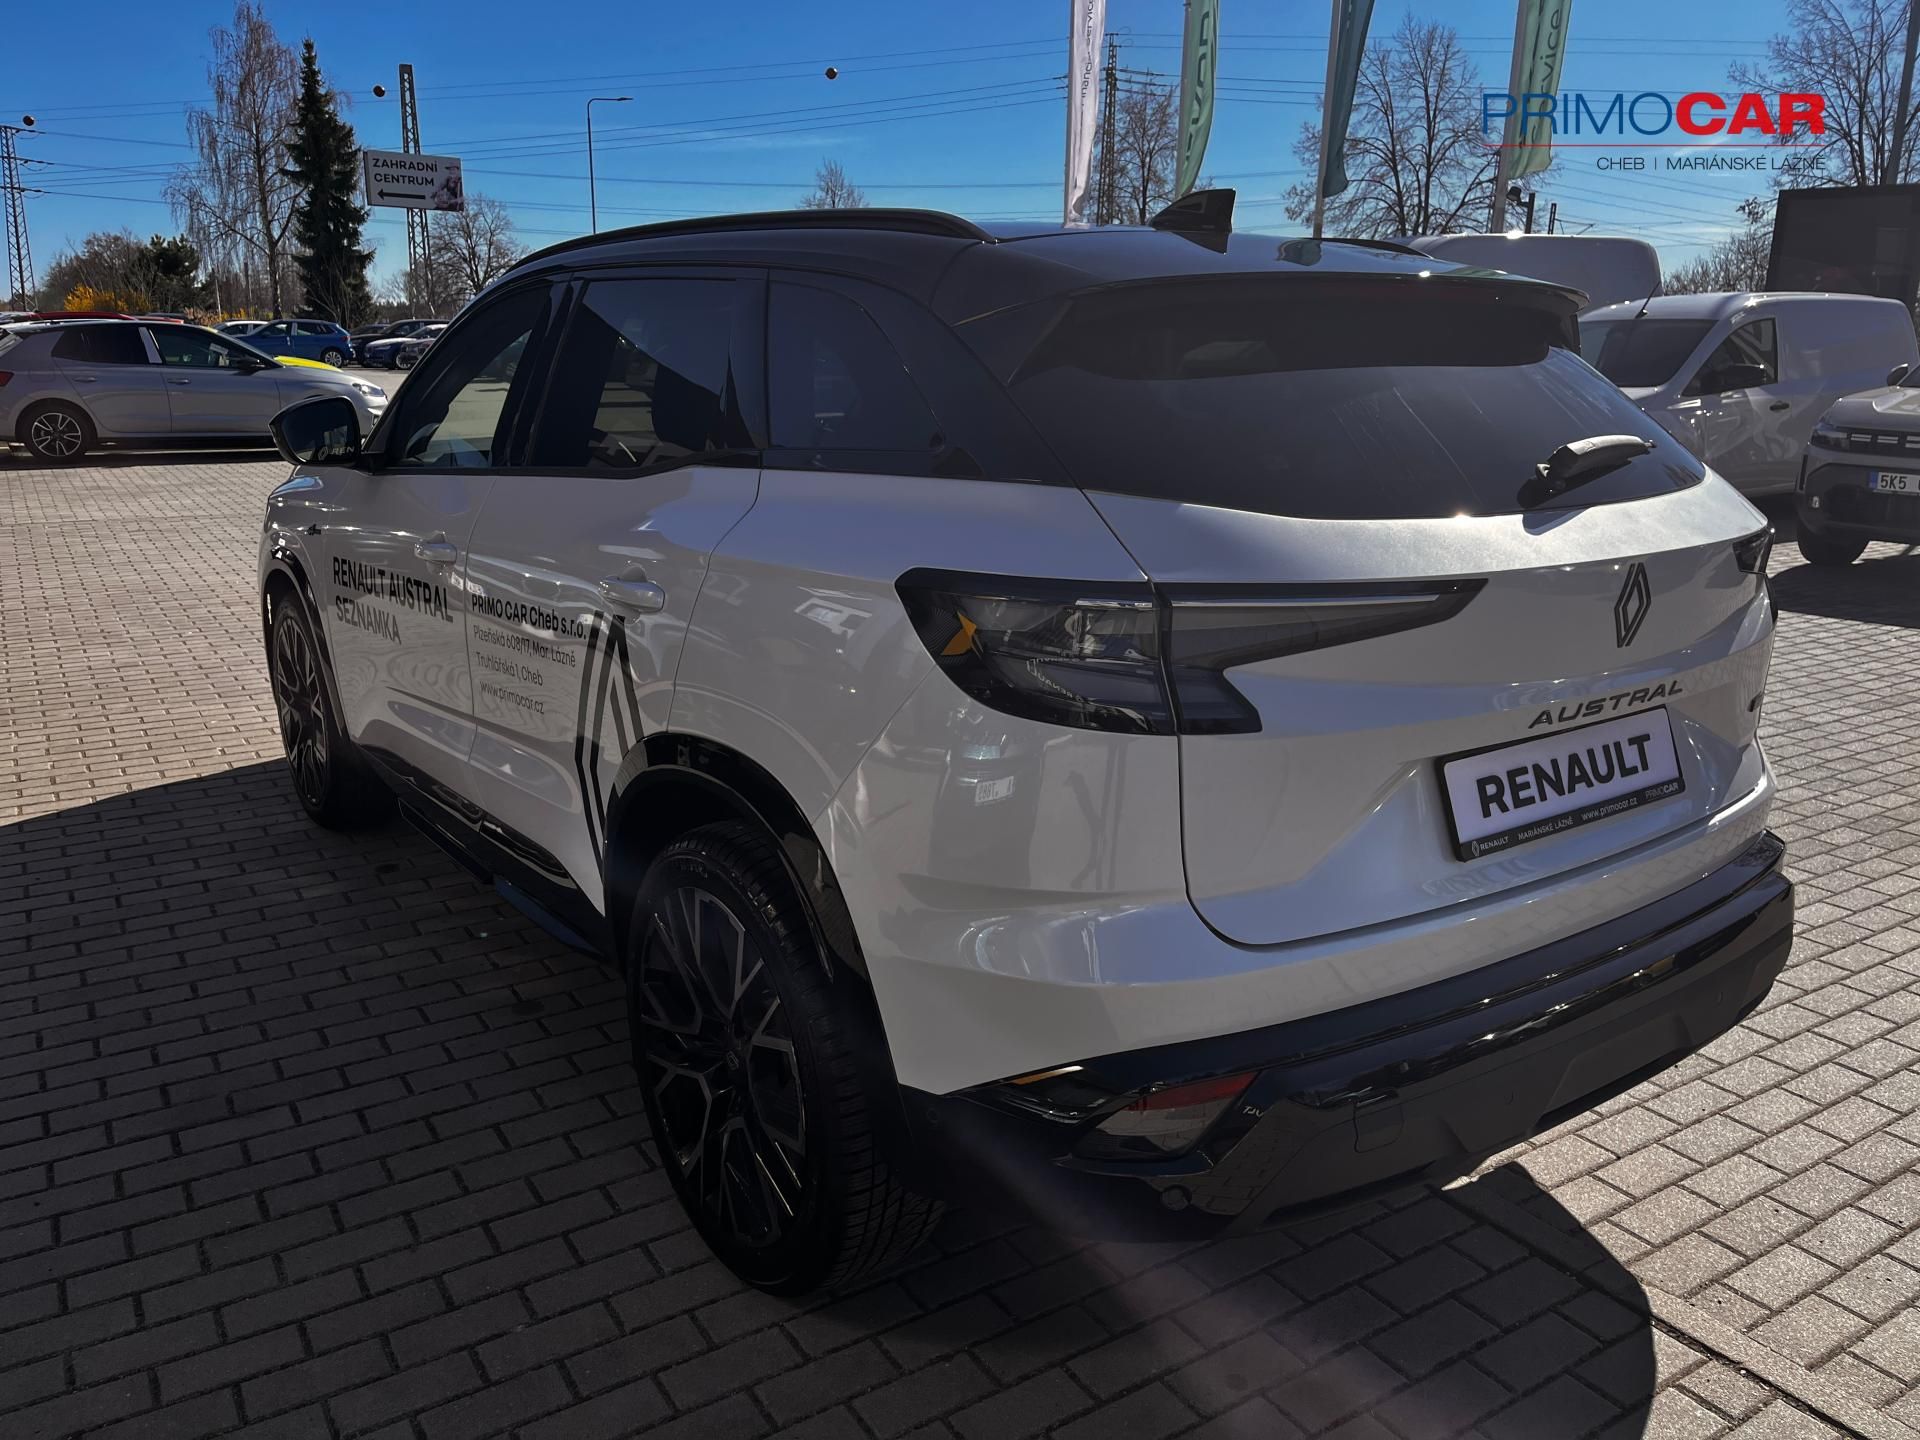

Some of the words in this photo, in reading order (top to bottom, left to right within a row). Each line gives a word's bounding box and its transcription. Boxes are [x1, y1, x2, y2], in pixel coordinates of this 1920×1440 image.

[372, 158, 438, 173] ZAHRADNÍ
[373, 173, 435, 187] CENTRUM
[1880, 474, 1907, 490] 5K5
[333, 556, 386, 600] RENAULT
[389, 572, 454, 624] AUSTRAL
[335, 595, 402, 646] SEZNAMKA
[471, 594, 503, 618] PRIMO
[504, 601, 528, 625] CAR
[529, 606, 559, 632] Cheb
[561, 617, 587, 640] s.r.o.
[473, 625, 506, 648] Plzeňská
[533, 641, 551, 660] Mar.
[551, 646, 576, 668] Lázně
[480, 681, 545, 715] www.primocar.cz
[521, 665, 544, 687] Cheb
[1528, 680, 1683, 729] AUSTRAL
[1476, 734, 1651, 819] RENAULT
[1480, 836, 1510, 851] RENAULT
[1518, 822, 1553, 841] MARIÁNSKÉ
[1555, 816, 1574, 831] LÁZNĚ
[1581, 797, 1638, 821] www.primocar.cz
[1645, 781, 1679, 799] PRIMOCAR
